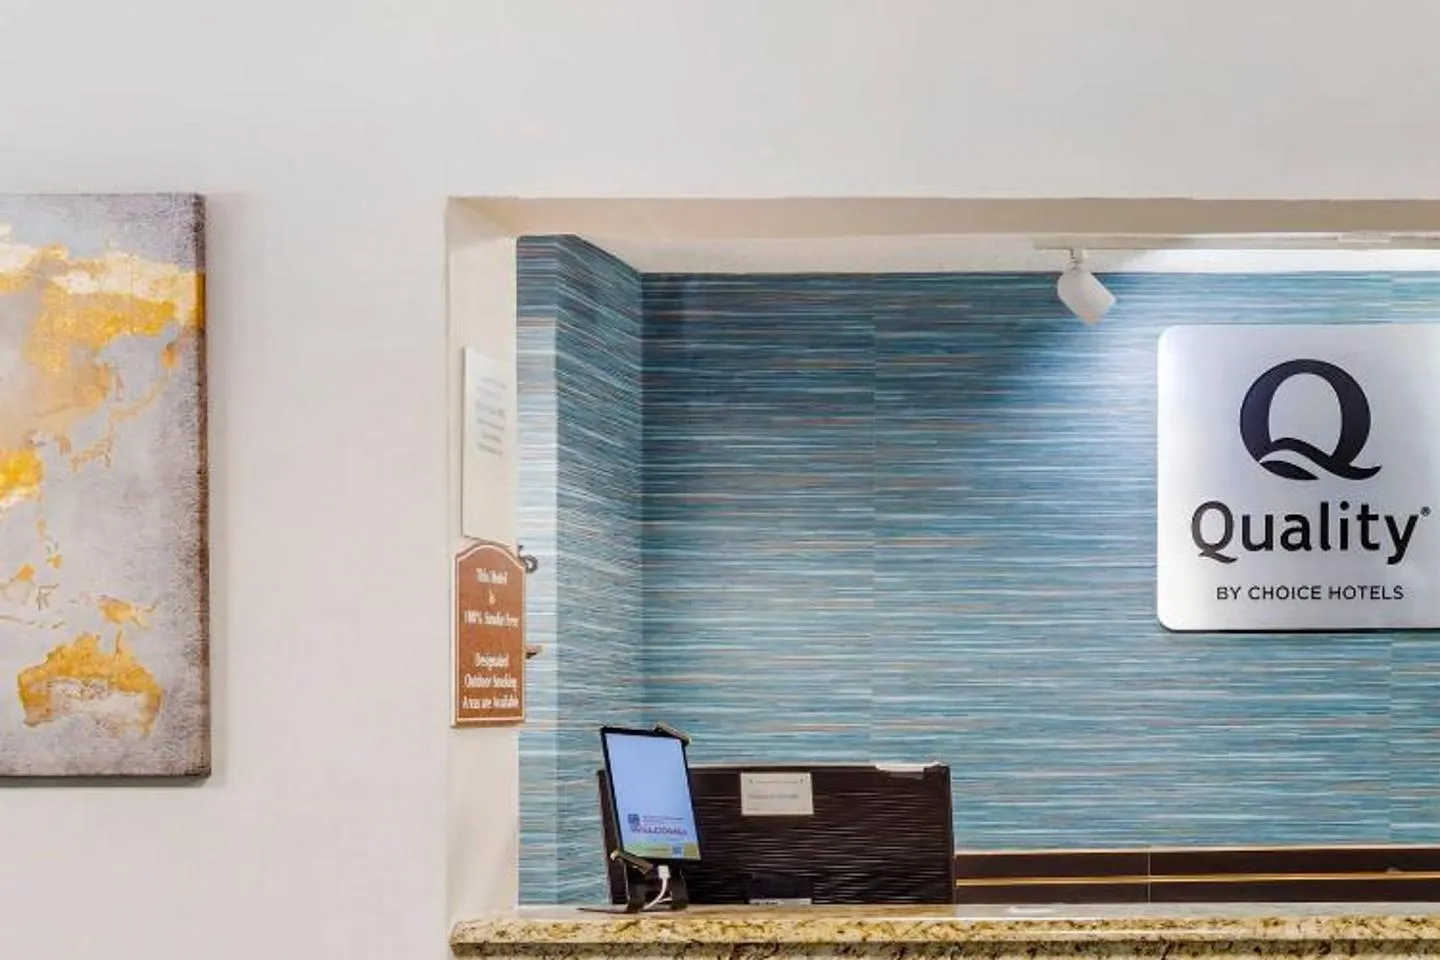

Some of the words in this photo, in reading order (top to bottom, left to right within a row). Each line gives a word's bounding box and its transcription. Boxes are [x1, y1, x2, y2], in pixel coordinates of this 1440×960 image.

[1216, 585, 1242, 600] BY
[1247, 585, 1322, 600] CHOICE
[1328, 585, 1404, 600] HOTELS
